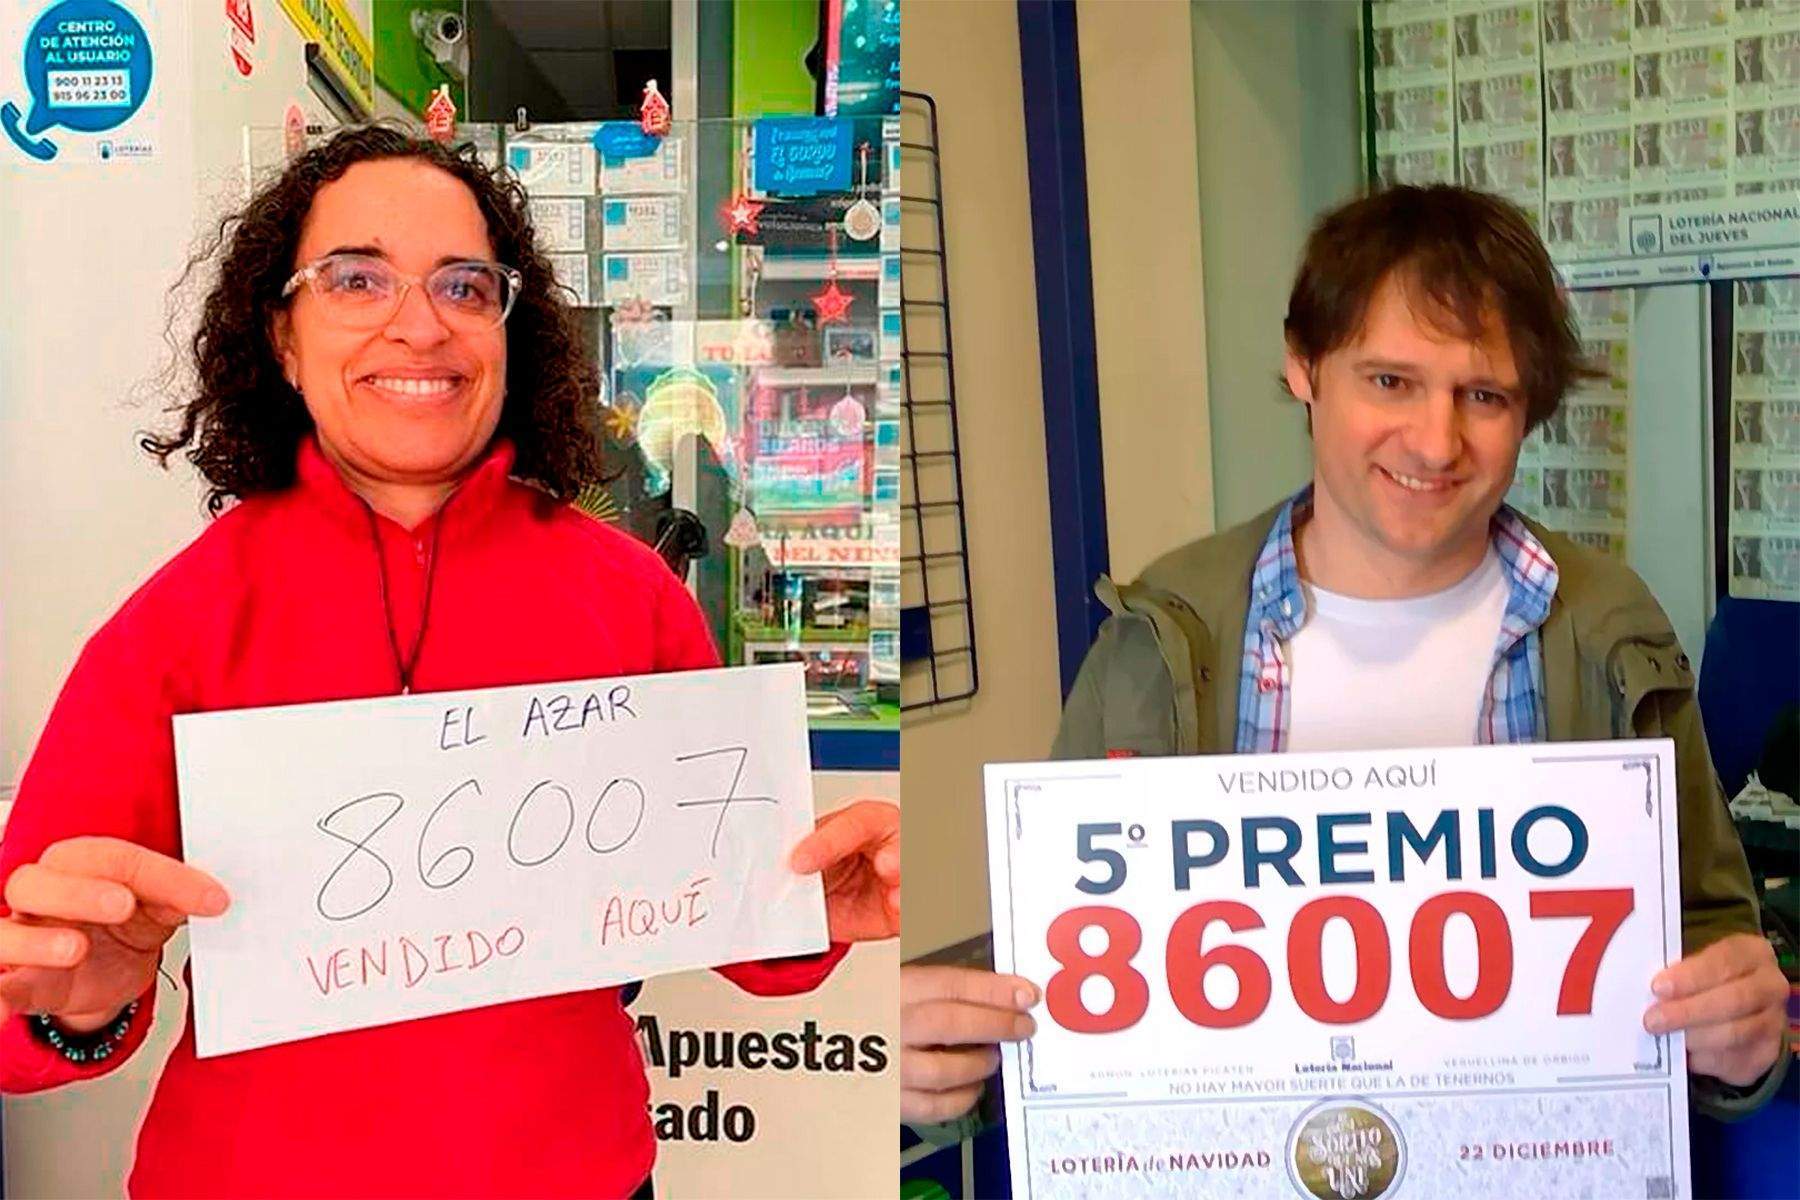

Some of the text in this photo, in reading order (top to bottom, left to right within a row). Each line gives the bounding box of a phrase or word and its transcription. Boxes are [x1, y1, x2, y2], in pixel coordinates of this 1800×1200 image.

[58, 20, 116, 33] CENTRO
[40, 32, 135, 48] DE ATENCIÓN
[45, 50, 131, 62] AL USUARIO
[55, 76, 79, 87] 900
[82, 76, 91, 86] 11
[110, 89, 127, 100] 00
[1669, 206, 1800, 231] LOTERÍA NACIONAL
[1670, 228, 1749, 246] DEL JUEVES
[439, 684, 638, 752] EL AZAR
[1218, 758, 1436, 795] VENDIDO AQUÍ
[316, 747, 778, 922] 86007
[1171, 804, 1590, 892] PREMIO
[306, 877, 711, 997] VENDIDO AQUÍ
[1045, 887, 1636, 1035] 86007
[637, 1014, 889, 1079] Apuestas
[1168, 1071, 1516, 1096] NO HAY MAYOR SUERTE QUE LA DE TENERNOS
[650, 1089, 757, 1143] ado
[1050, 1150, 1140, 1175] LOTERÍA
[1168, 1150, 1272, 1173] NAVIDAD
[1459, 1139, 1615, 1161] 22 DICIEMBRE
